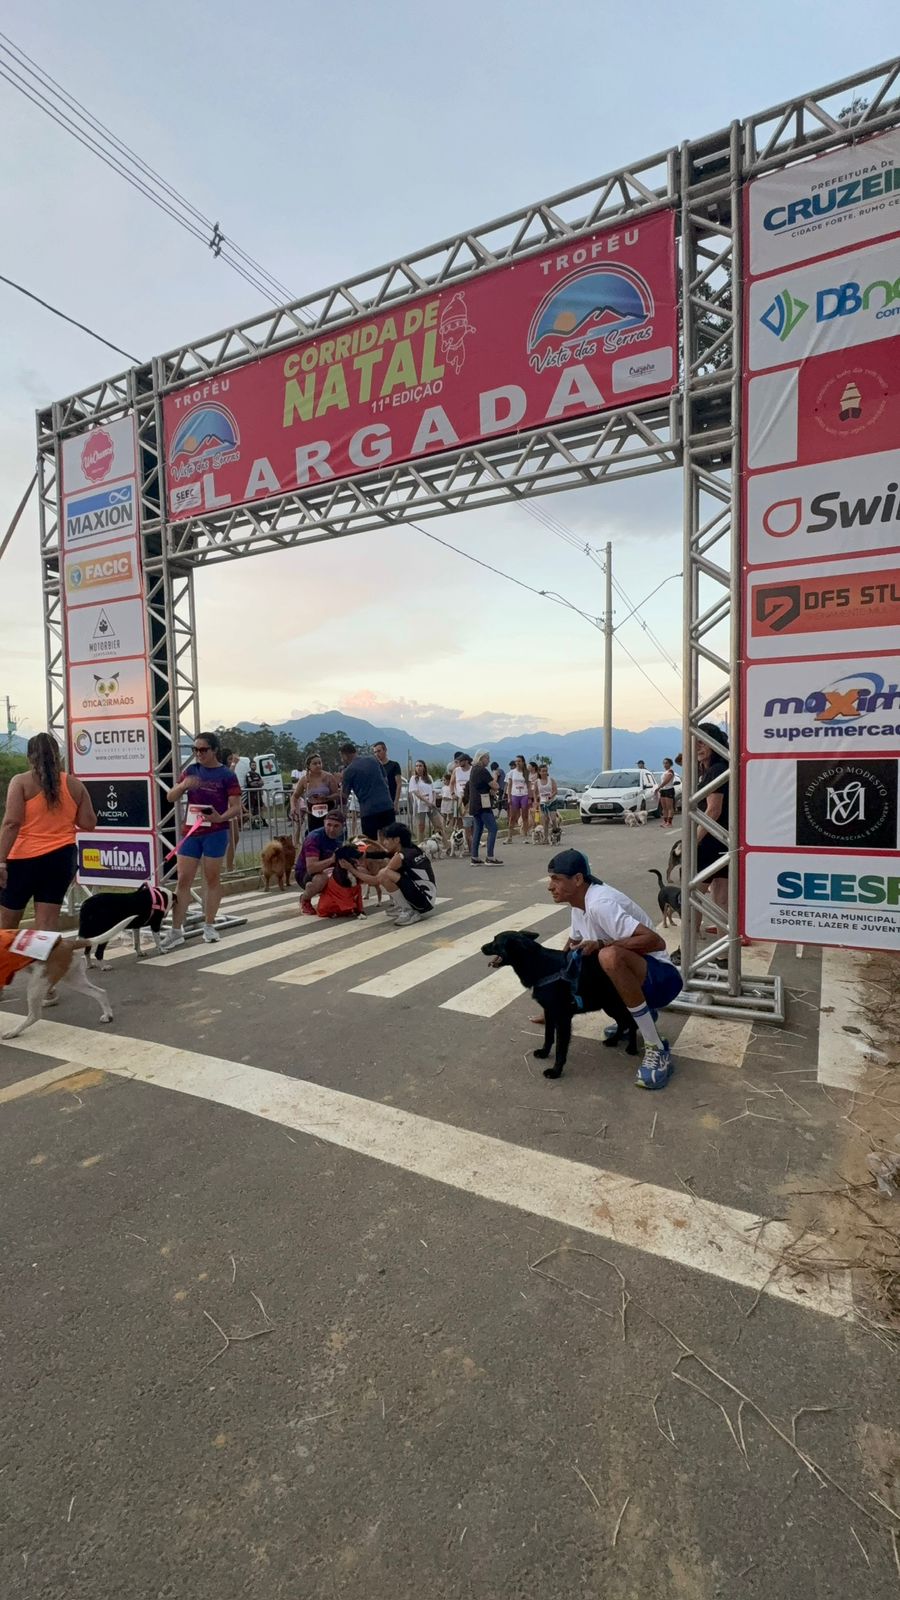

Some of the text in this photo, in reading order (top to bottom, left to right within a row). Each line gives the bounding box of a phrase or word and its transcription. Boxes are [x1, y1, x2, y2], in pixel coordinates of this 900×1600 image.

[811, 160, 894, 192] PREFEITURA DE
[763, 168, 900, 231] CRUZEI
[791, 223, 823, 238] CIDADE
[825, 213, 856, 228] FORTE,
[859, 203, 886, 217] RUMO
[540, 228, 640, 276] TROFÉU
[283, 301, 441, 378] CORRIDA DE
[529, 326, 654, 374] Vista das Serras
[174, 378, 230, 409] TROFÉU
[282, 329, 446, 428] NATAL
[371, 397, 390, 413] 11ª
[203, 364, 606, 511] LARGADA
[67, 503, 133, 537] MAXION
[85, 557, 129, 580] FACIC
[89, 639, 121, 652] MOTORBIER
[94, 729, 145, 744] CENTER
[805, 766, 888, 797] EDUARDO MODESTO
[100, 846, 146, 867] MÍDIA
[770, 917, 816, 928] ESPORTE,
[818, 921, 849, 930] LAZER
[852, 923, 858, 931] E
[779, 909, 897, 924] SECRETARIA MUNICIPAL
